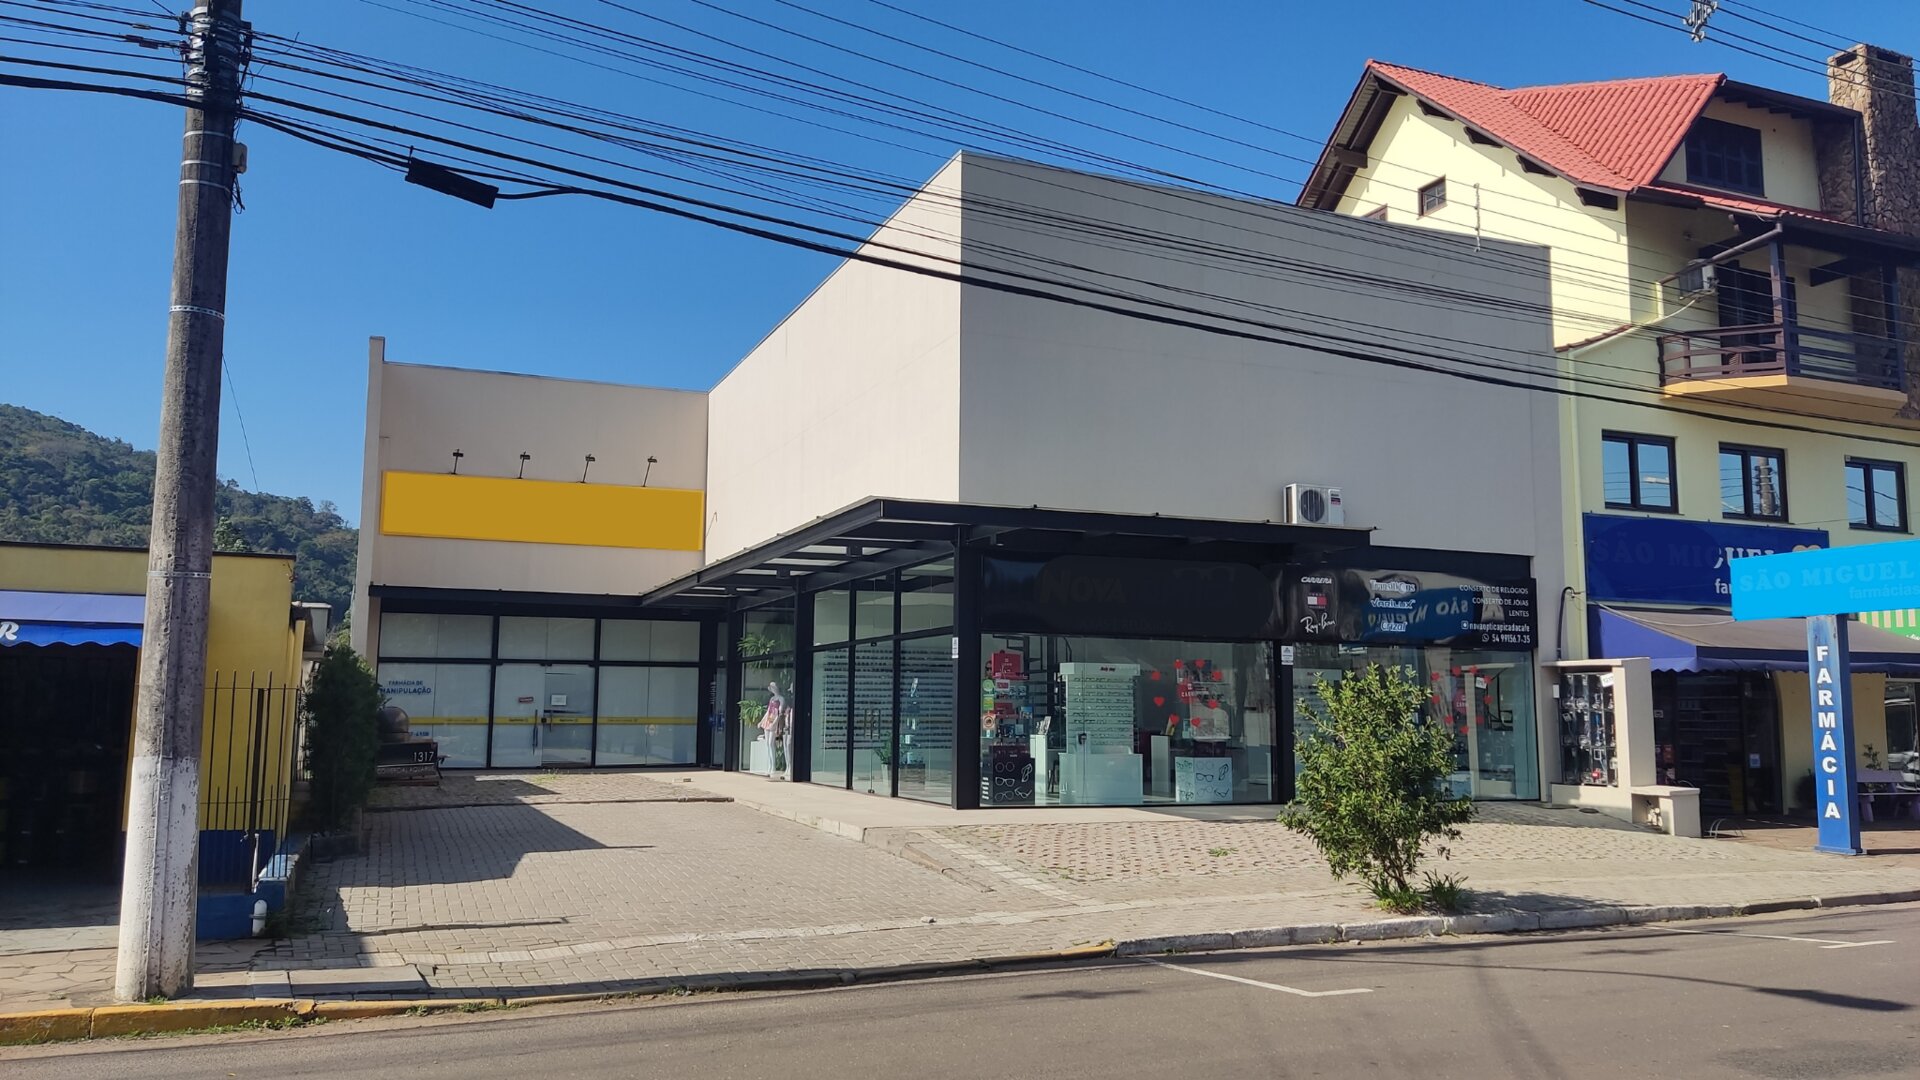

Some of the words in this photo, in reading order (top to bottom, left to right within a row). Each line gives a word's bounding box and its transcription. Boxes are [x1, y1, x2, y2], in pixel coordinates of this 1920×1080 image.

[1301, 576, 1332, 584] CARRERA
[1739, 568, 1792, 592] SÃO
[1801, 560, 1915, 587] MIGUEL
[1459, 584, 1490, 593] CONSERTO
[1472, 597, 1503, 606] CONSERTO
[1504, 598, 1512, 606] DE
[1816, 645, 1842, 820] FARMÁCIA
[413, 751, 435, 762] 1317
